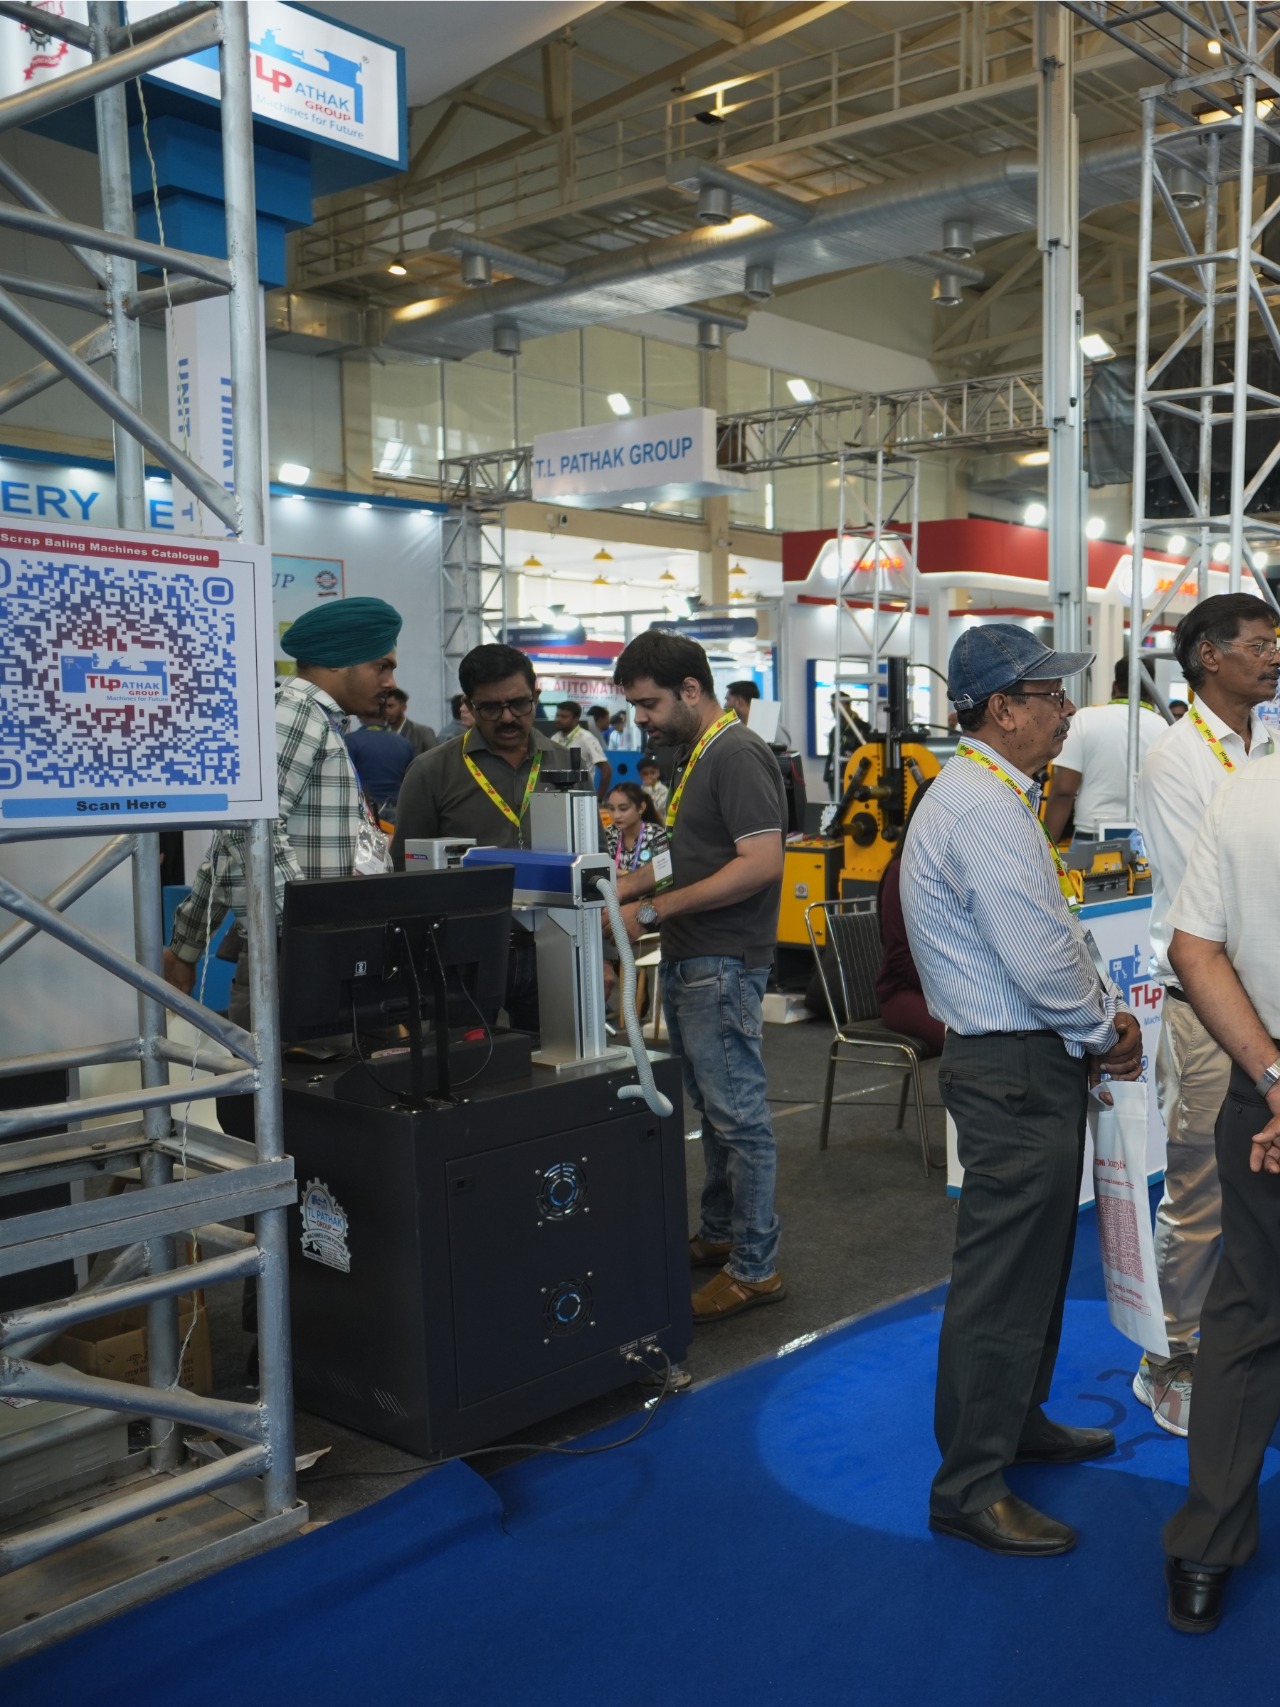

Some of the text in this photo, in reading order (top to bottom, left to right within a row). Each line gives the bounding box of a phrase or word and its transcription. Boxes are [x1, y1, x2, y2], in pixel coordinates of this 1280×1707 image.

[256, 94, 364, 140] Machines for Future
[304, 100, 351, 121] GROUP
[561, 447, 624, 475] PATHAK
[630, 436, 692, 465] GROUP
[0, 534, 209, 562] Scrap Baling Machines Catalogue
[76, 800, 167, 812] Scan Here
[317, 1210, 342, 1227] PATHAK
